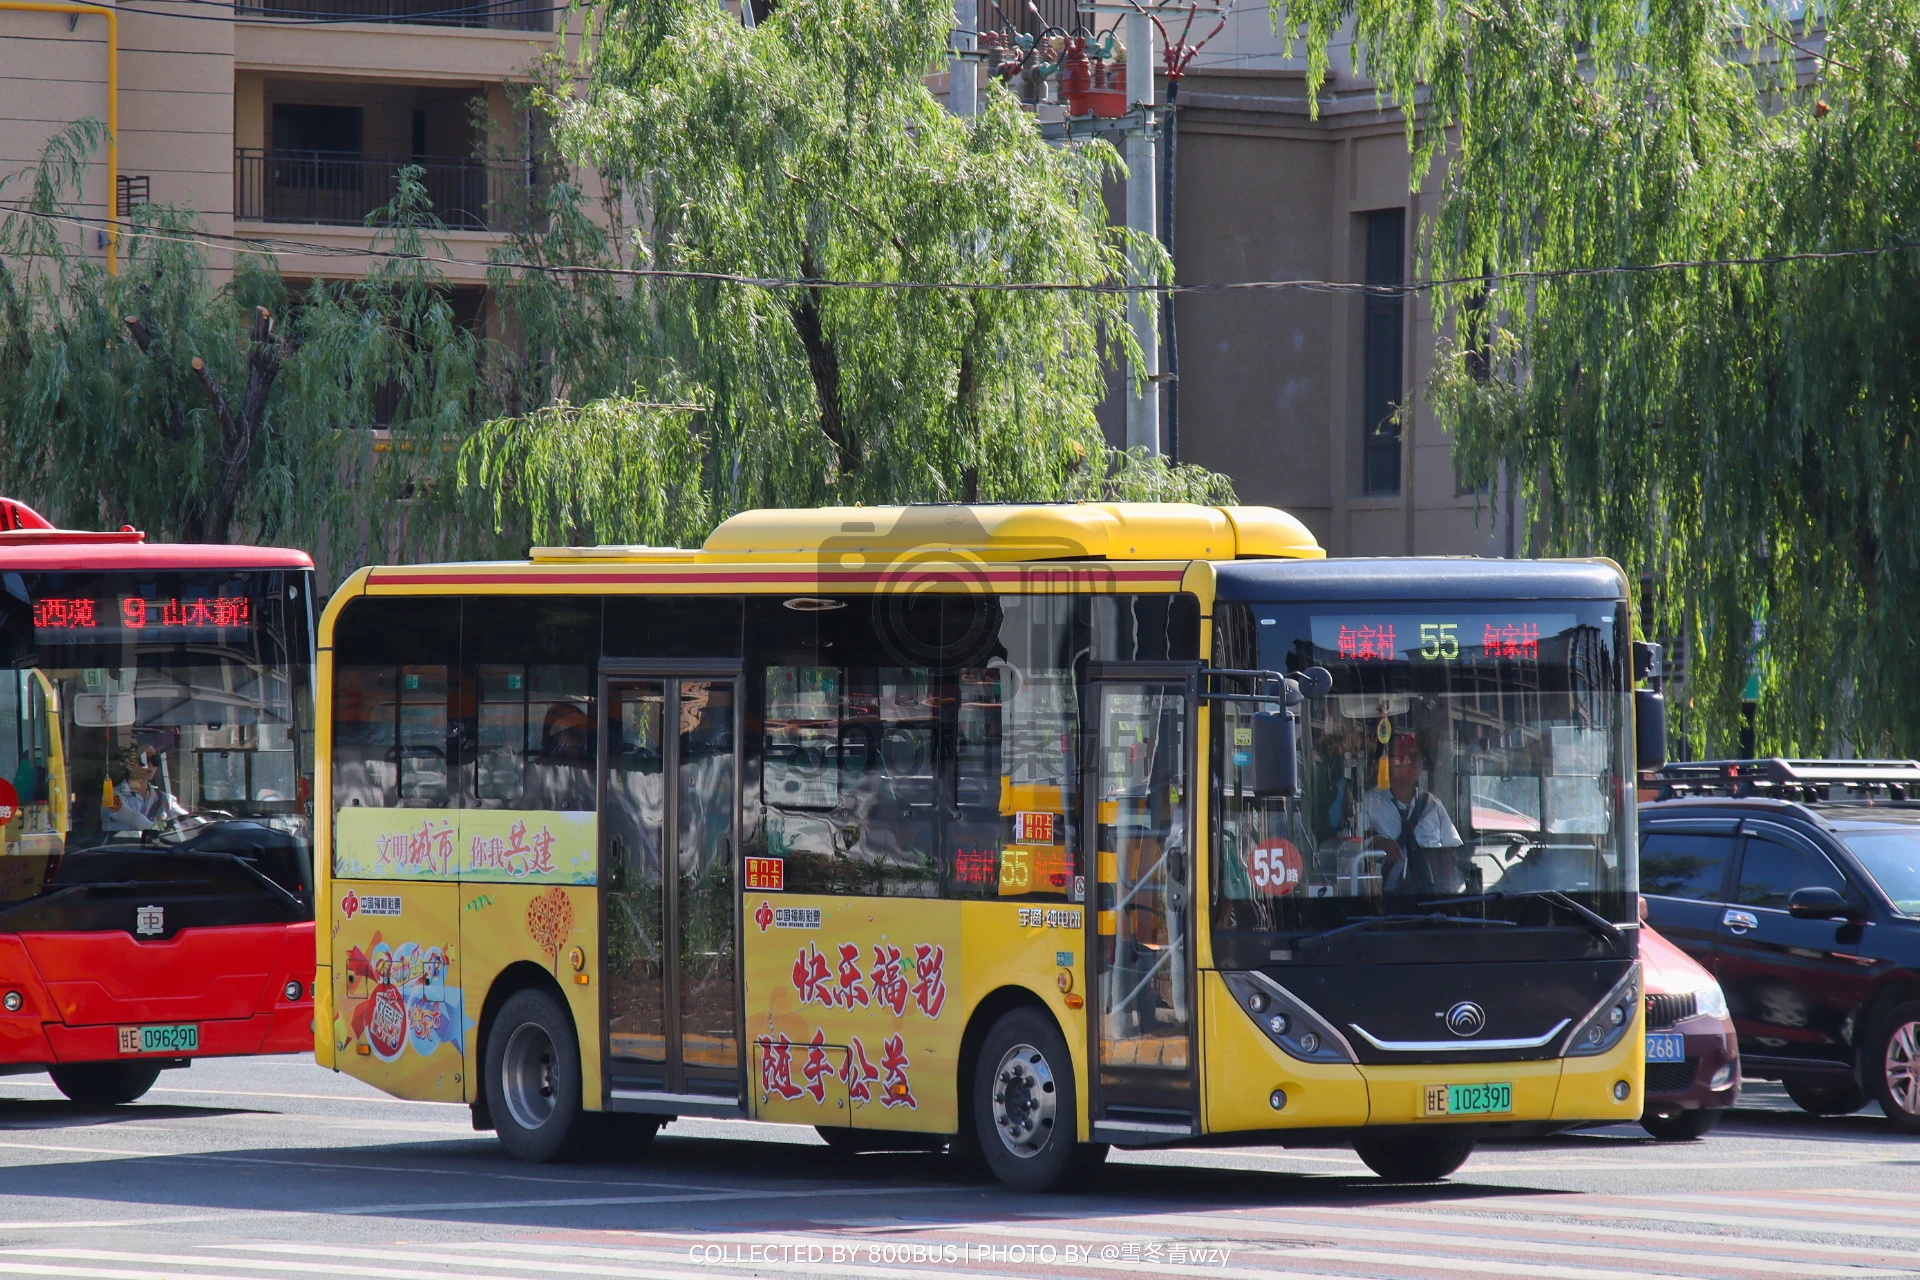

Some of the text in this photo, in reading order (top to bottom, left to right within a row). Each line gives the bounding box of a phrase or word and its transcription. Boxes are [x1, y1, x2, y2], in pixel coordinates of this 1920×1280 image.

[123, 598, 146, 628] 9
[162, 597, 249, 627] 山水新
[1420, 623, 1459, 660] 55
[1026, 813, 1052, 826] 前门上
[1026, 826, 1052, 840] 后门下
[375, 818, 558, 878] 文明城市 你我共建
[749, 859, 779, 874] 前门上
[749, 873, 779, 888] 后门下
[1001, 851, 1028, 887] 55
[776, 909, 821, 922] 中国福利彩票
[792, 941, 947, 1020] 快乐福彩
[757, 1027, 919, 1111] 随手公益
